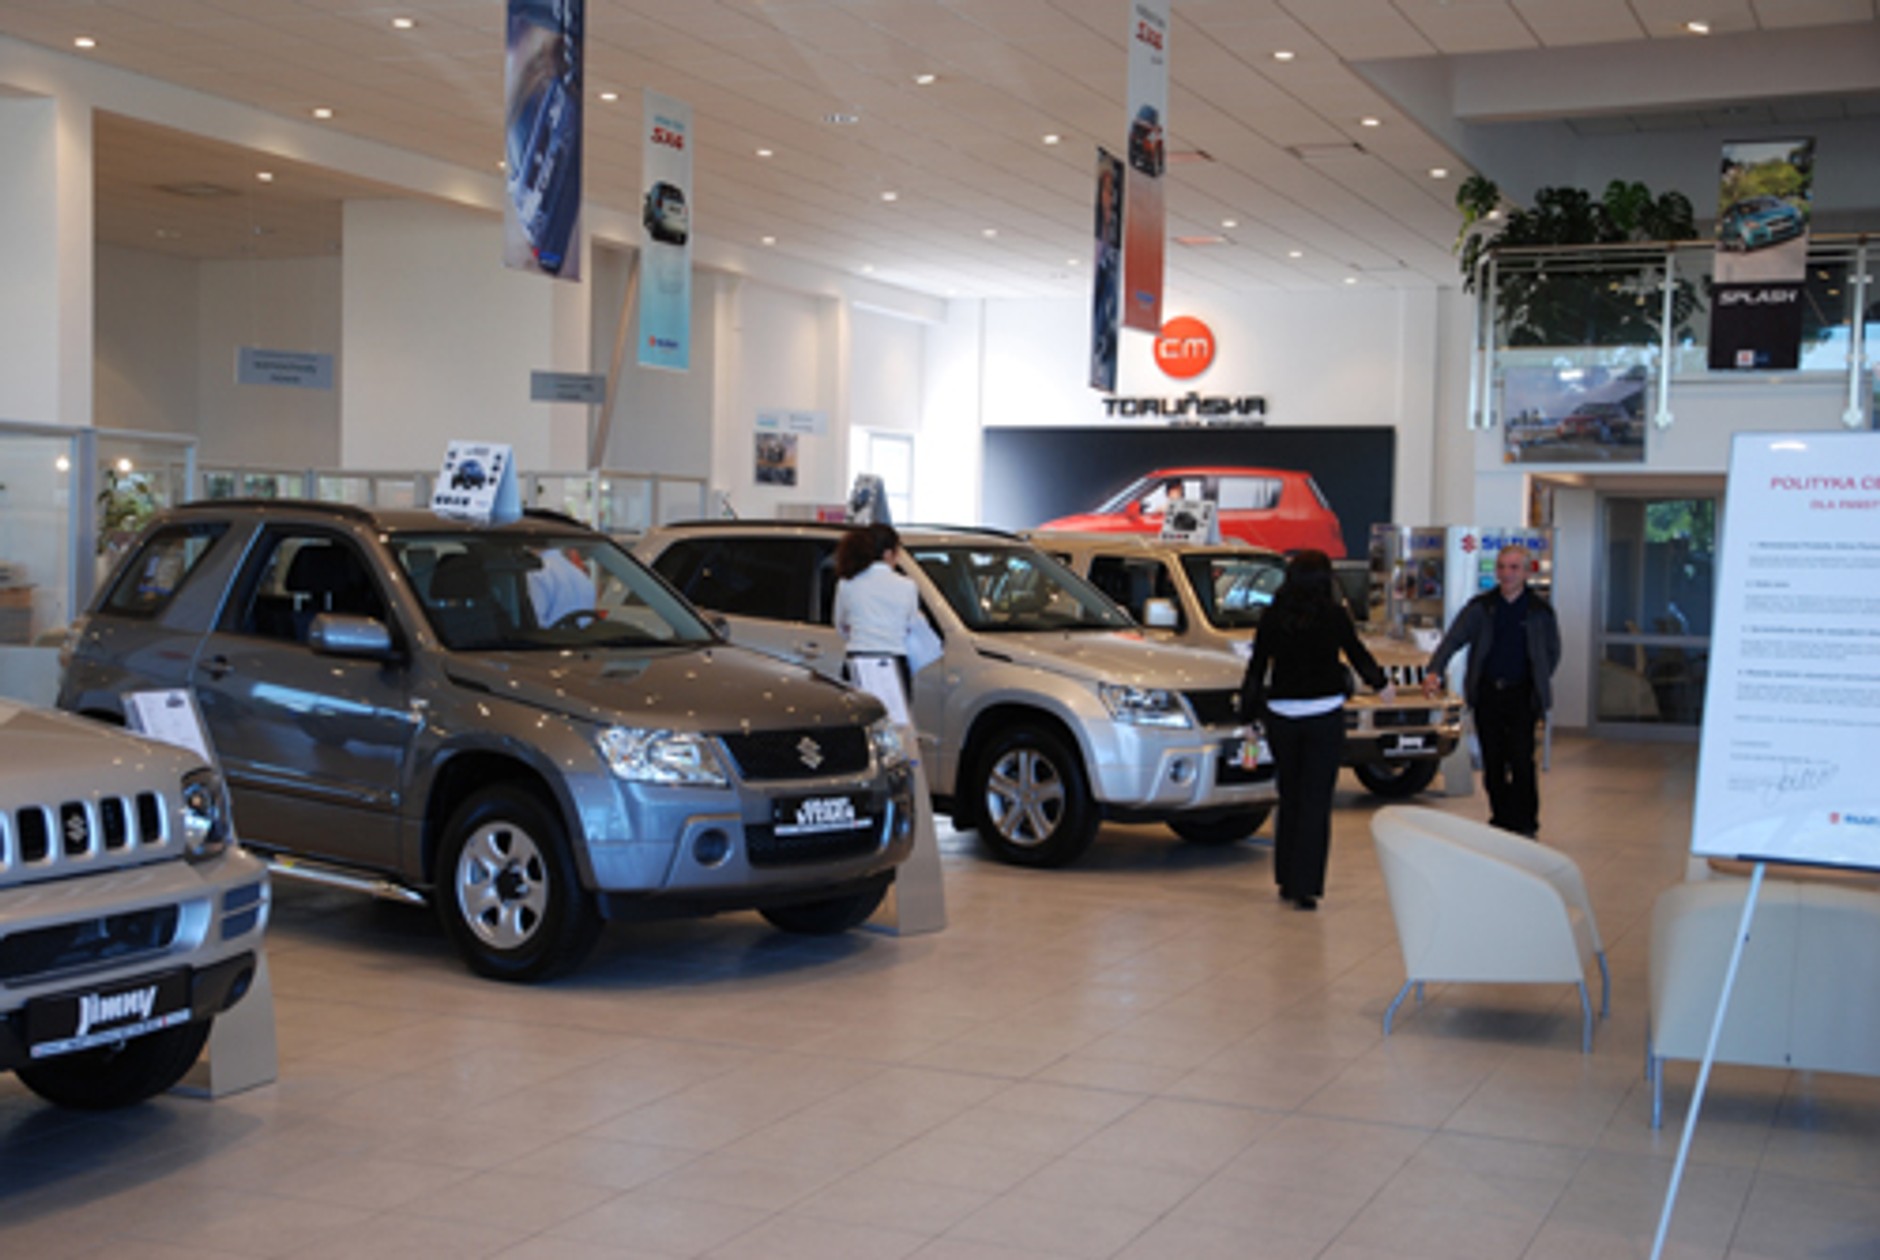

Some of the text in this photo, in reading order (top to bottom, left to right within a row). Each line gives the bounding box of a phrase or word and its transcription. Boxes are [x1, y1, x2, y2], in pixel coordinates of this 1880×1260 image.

[1719, 289, 1798, 306] SPLASH
[1770, 475, 1857, 491] POLITYKA
[76, 985, 158, 1037] Jimny
